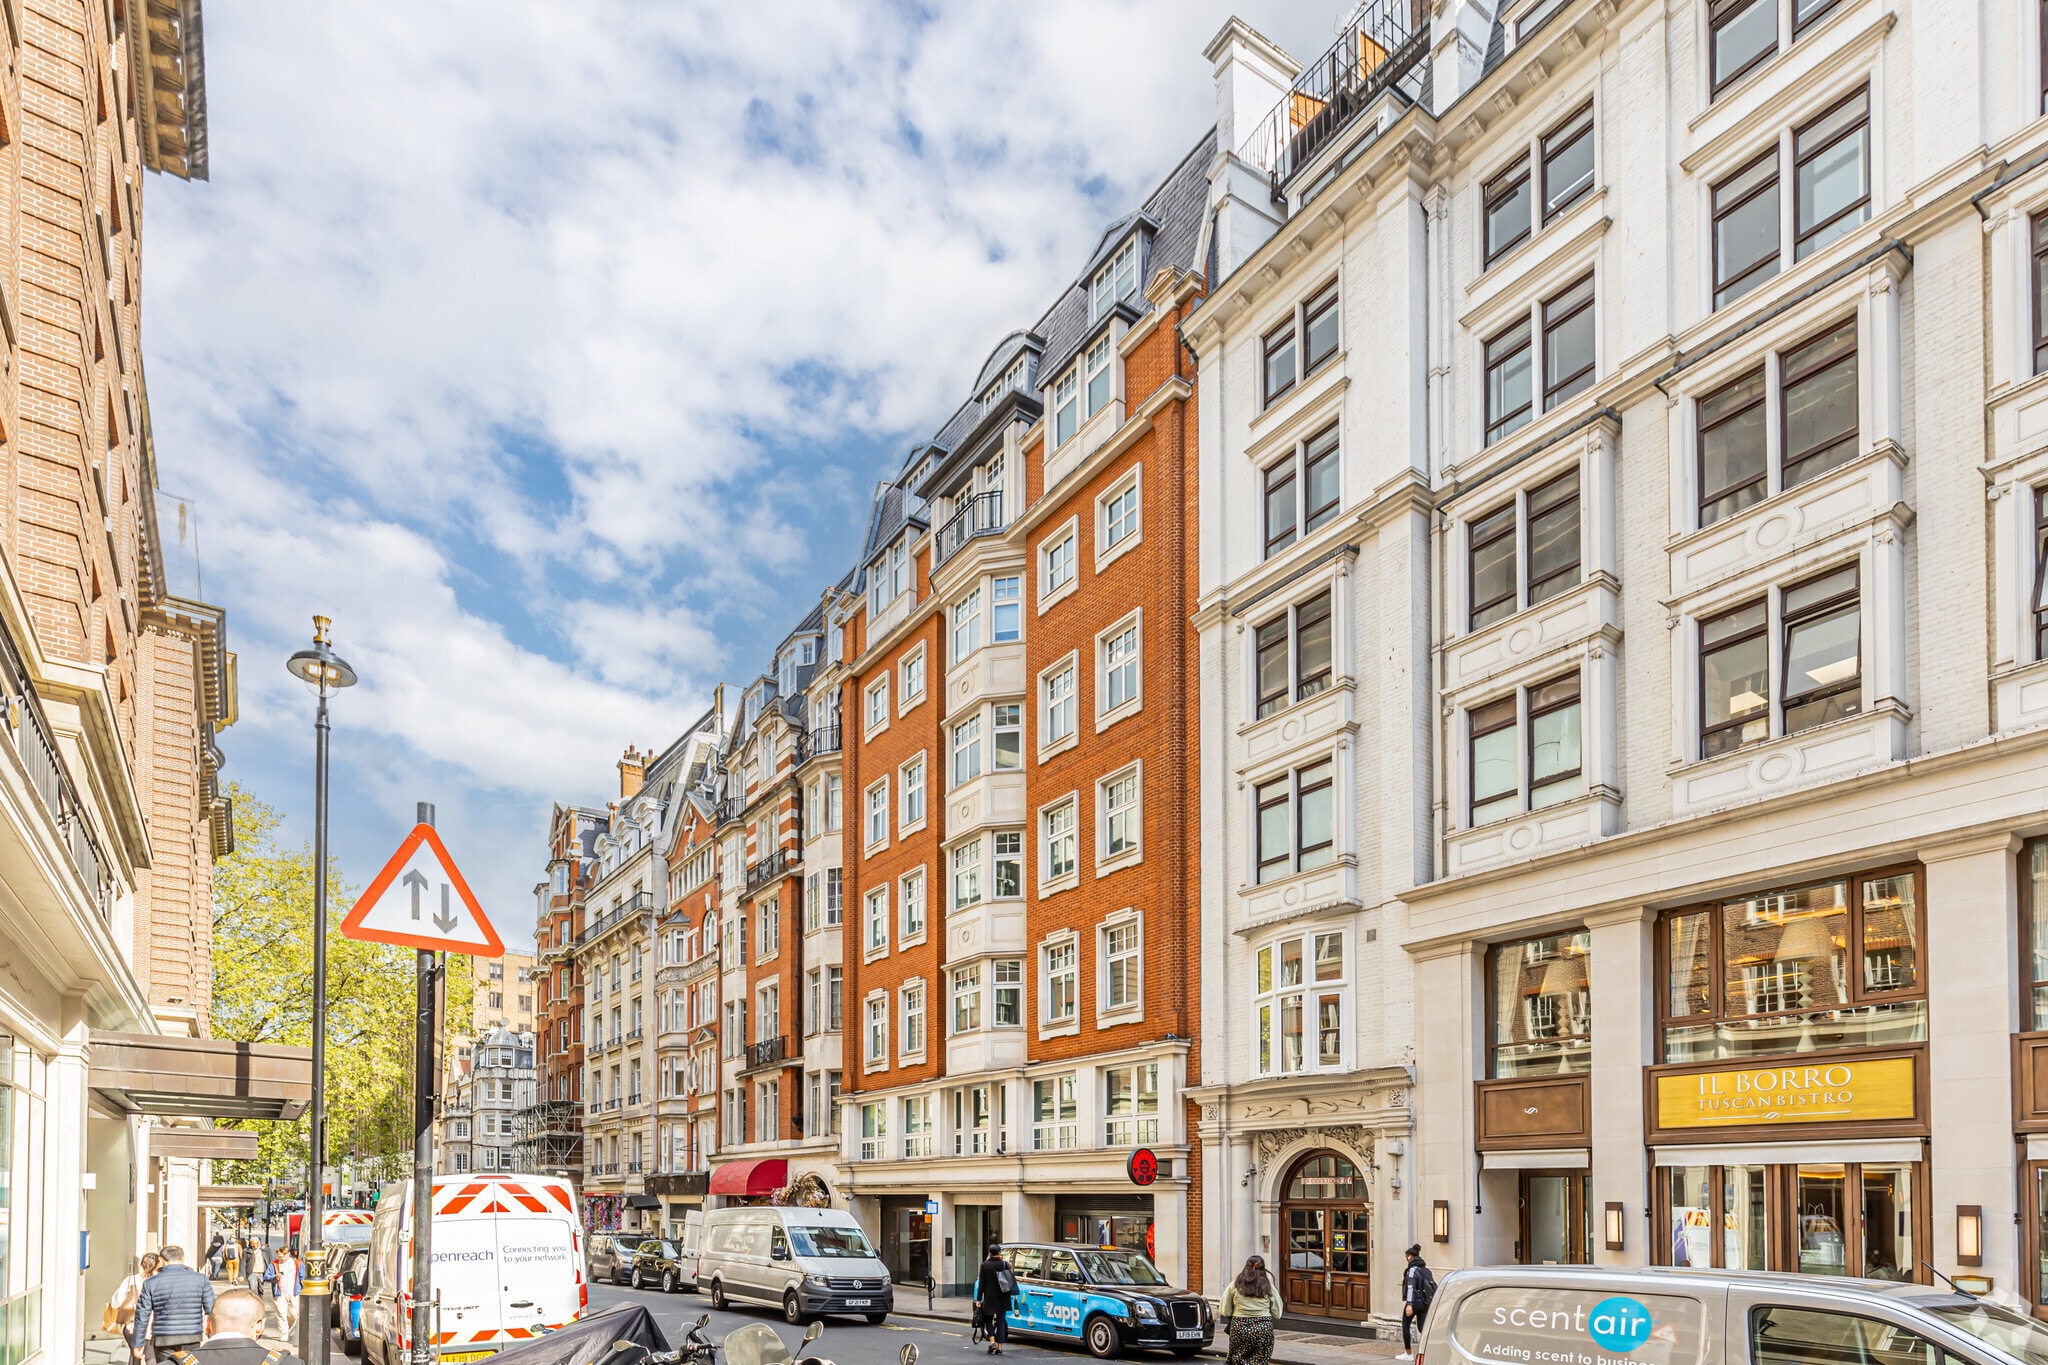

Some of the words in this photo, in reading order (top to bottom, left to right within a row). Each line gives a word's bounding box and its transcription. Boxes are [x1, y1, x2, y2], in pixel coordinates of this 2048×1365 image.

[1699, 1075, 1724, 1095] IL
[1736, 1066, 1852, 1093] BORRO
[430, 1250, 494, 1263] penreach
[502, 1245, 549, 1254] Connecting
[504, 1255, 512, 1263] to
[513, 1255, 532, 1263] your
[534, 1254, 567, 1262] network
[1046, 1302, 1080, 1326] Zapp
[1482, 1343, 1531, 1360] Adding
[1535, 1348, 1573, 1363] scent
[1577, 1352, 1592, 1365] to
